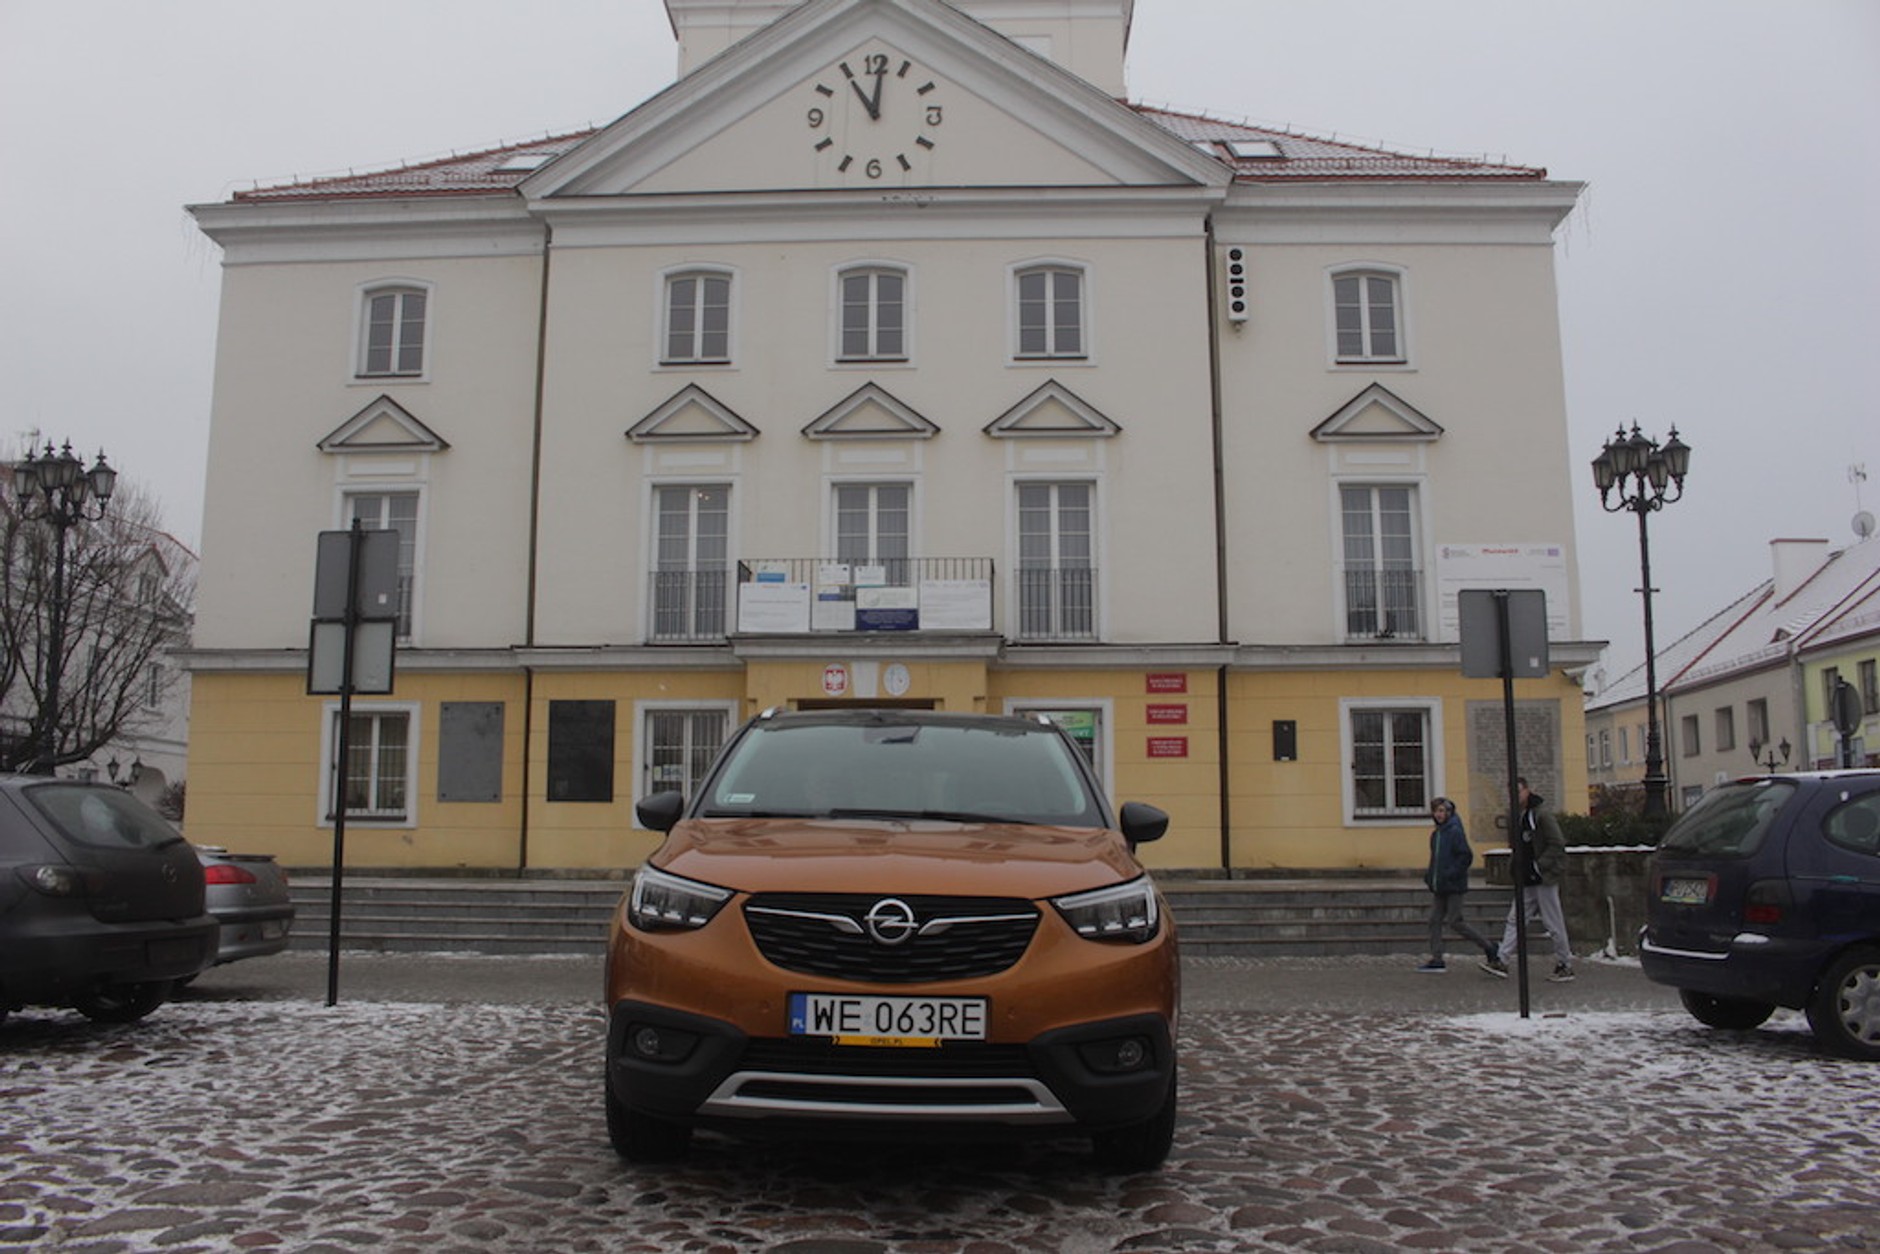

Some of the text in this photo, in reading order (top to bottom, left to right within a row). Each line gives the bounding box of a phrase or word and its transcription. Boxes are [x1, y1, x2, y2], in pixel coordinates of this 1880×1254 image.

[864, 54, 889, 75] 12
[807, 108, 824, 128] 9
[926, 106, 943, 126] 3
[866, 159, 883, 179] 6
[792, 1018, 804, 1029] PL
[814, 999, 981, 1035] WE 063RE
